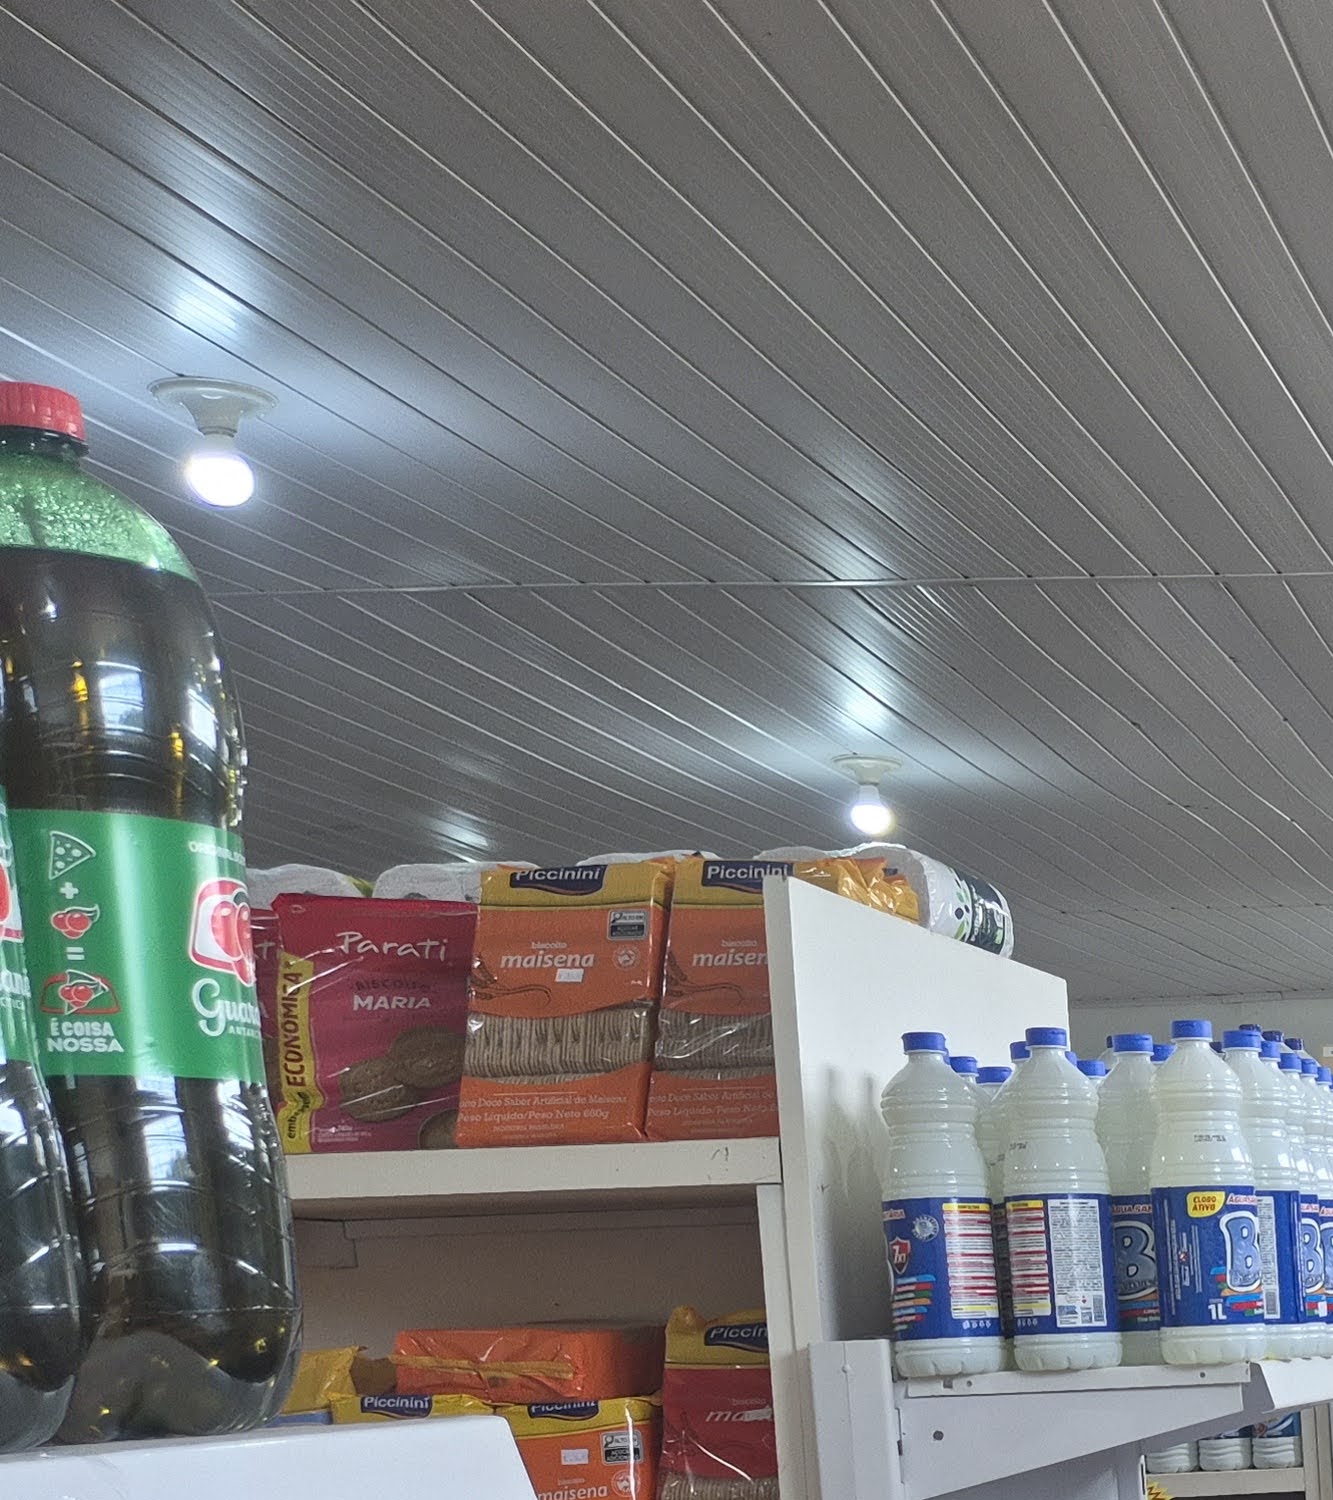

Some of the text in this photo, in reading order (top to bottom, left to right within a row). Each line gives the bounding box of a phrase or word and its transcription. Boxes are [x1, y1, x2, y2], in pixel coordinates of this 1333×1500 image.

[516, 867, 601, 881] Piccinini
[336, 930, 449, 961] Parati
[500, 951, 595, 969] maisena
[353, 994, 432, 1011] MARIA
[51, 1018, 115, 1037] É COISA
[48, 1037, 125, 1053] NOSSA
[1208, 1302, 1228, 1321] 1L
[364, 1395, 432, 1410] Piccinini
